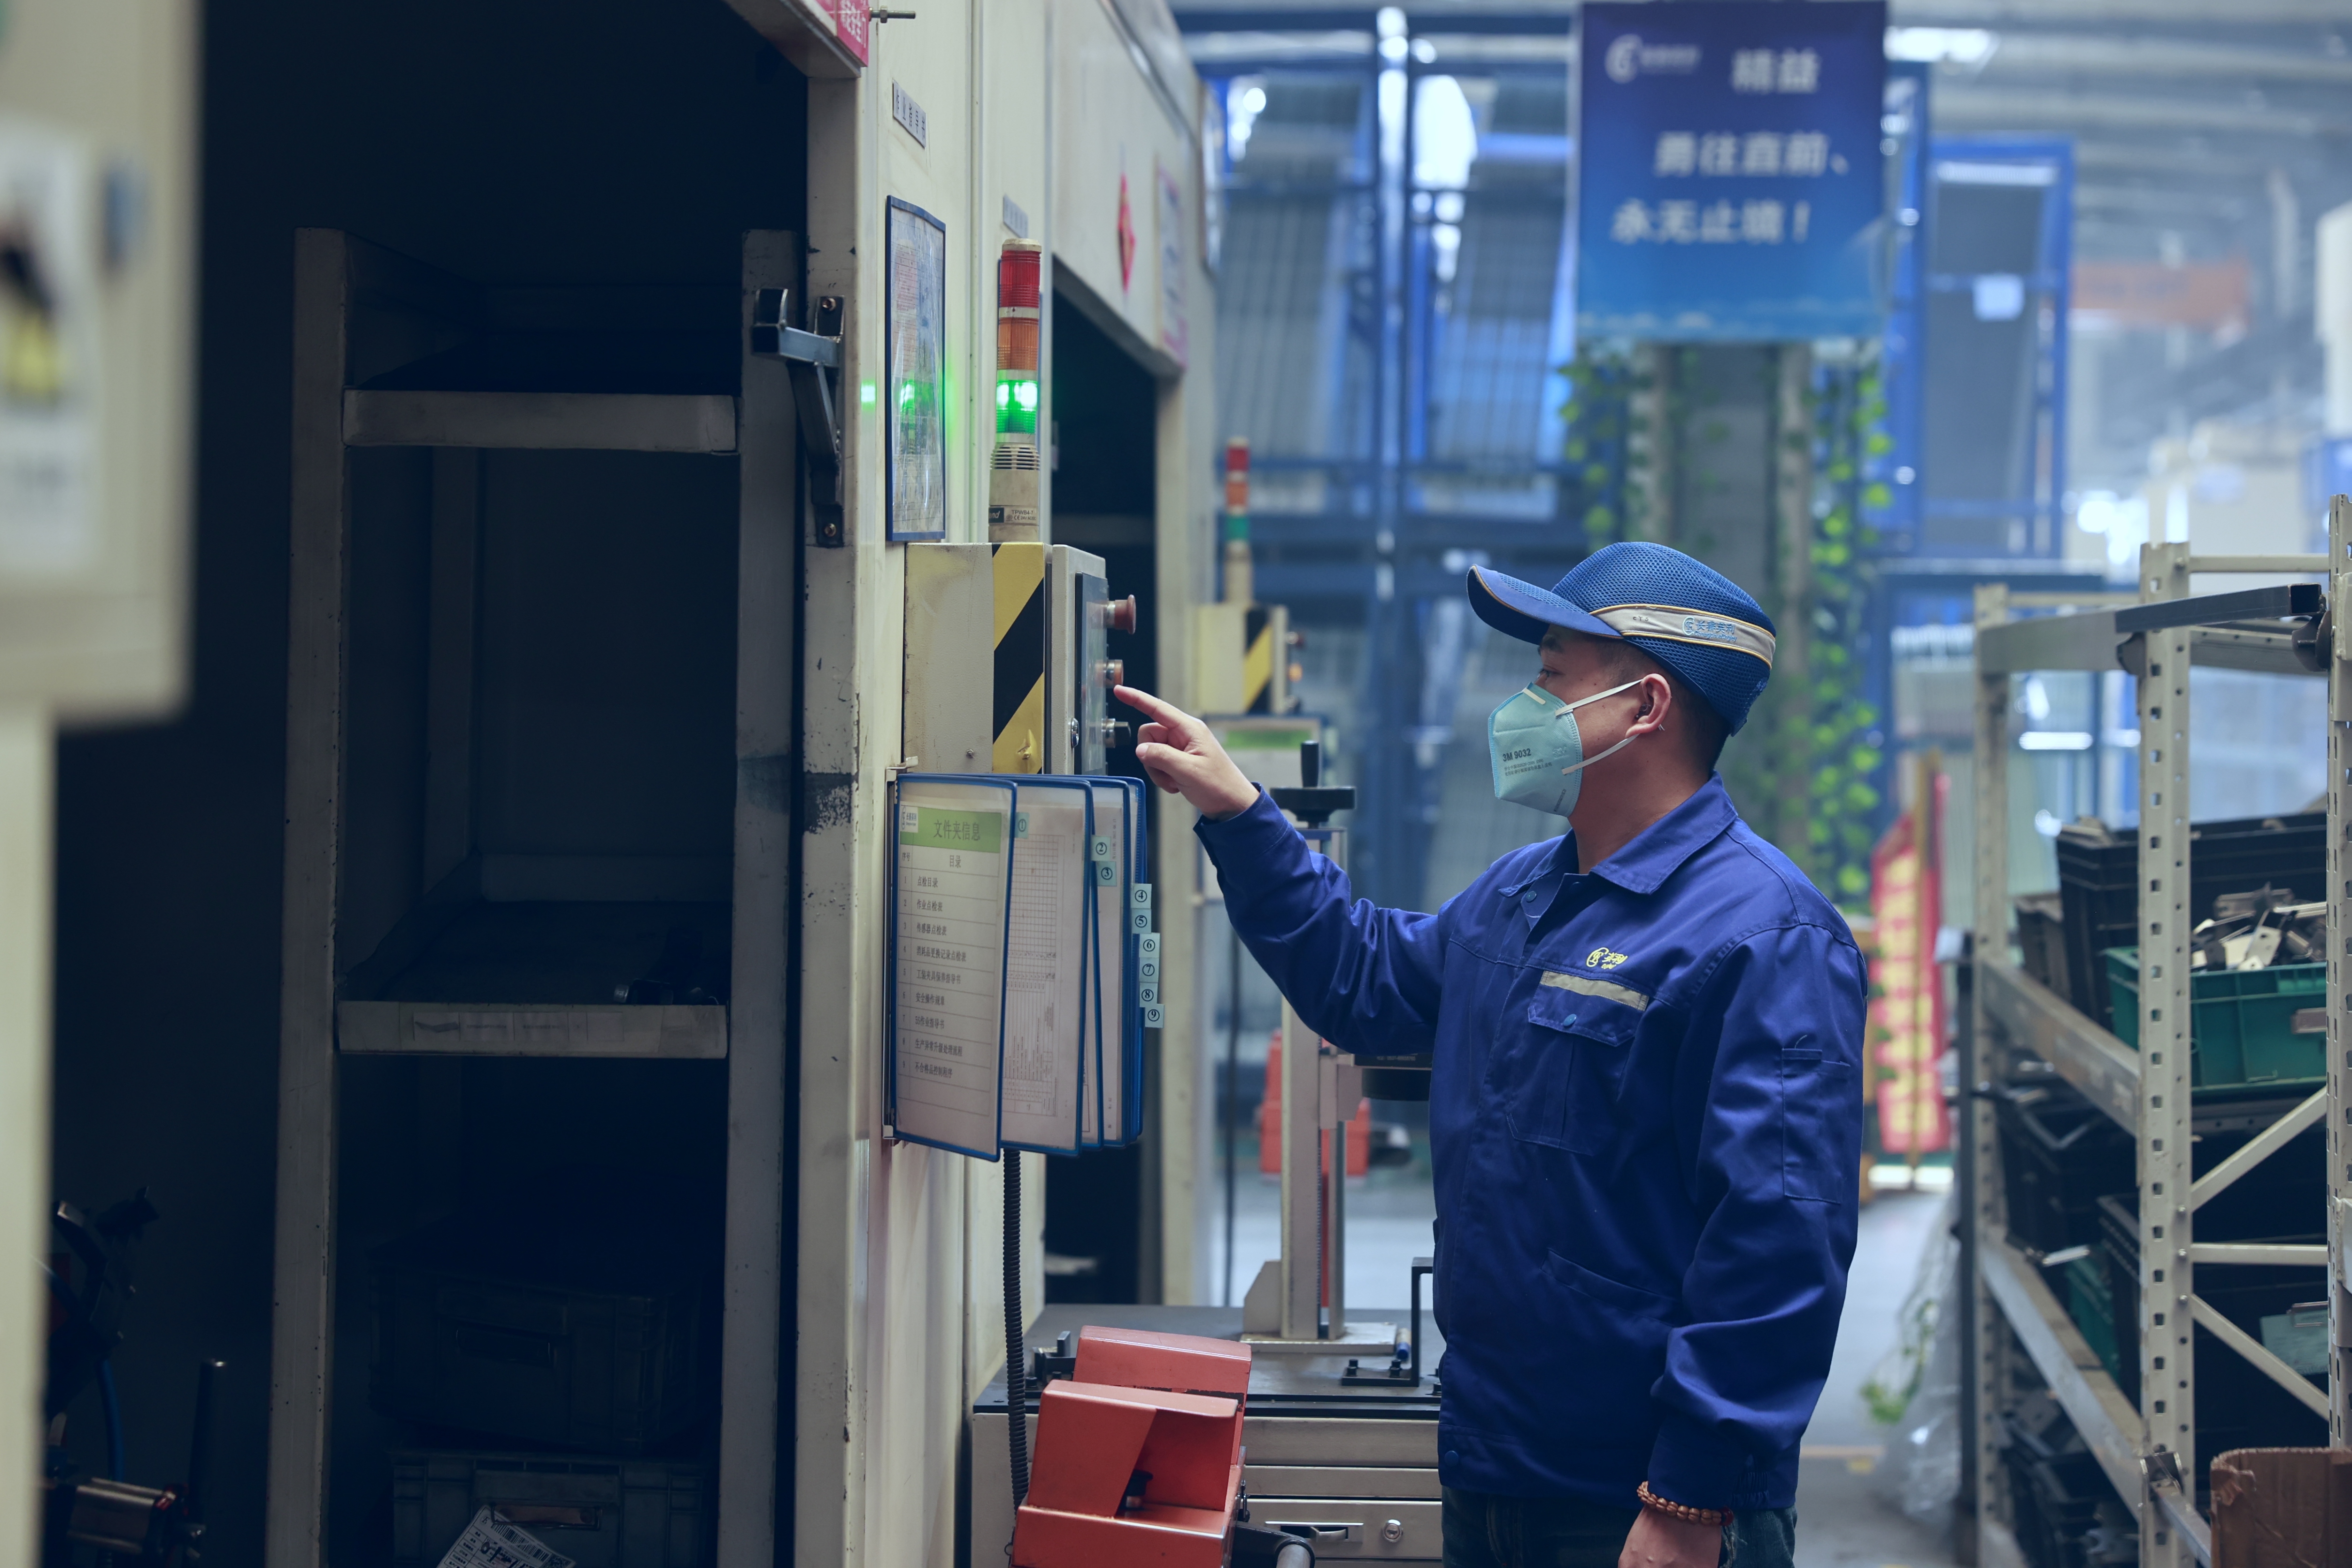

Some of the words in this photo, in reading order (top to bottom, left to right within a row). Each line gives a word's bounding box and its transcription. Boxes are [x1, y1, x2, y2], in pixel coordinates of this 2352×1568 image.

[1695, 620, 1736, 635] 长春英利
[1503, 752, 1513, 762] 3M
[1514, 748, 1531, 759] 9032
[933, 819, 980, 842] 文件夹信息
[902, 852, 910, 862] 序号
[949, 855, 962, 868] 目录
[917, 876, 938, 888] 点检目录
[917, 900, 942, 911] 作业点检表
[917, 922, 947, 936] 传感器点检表
